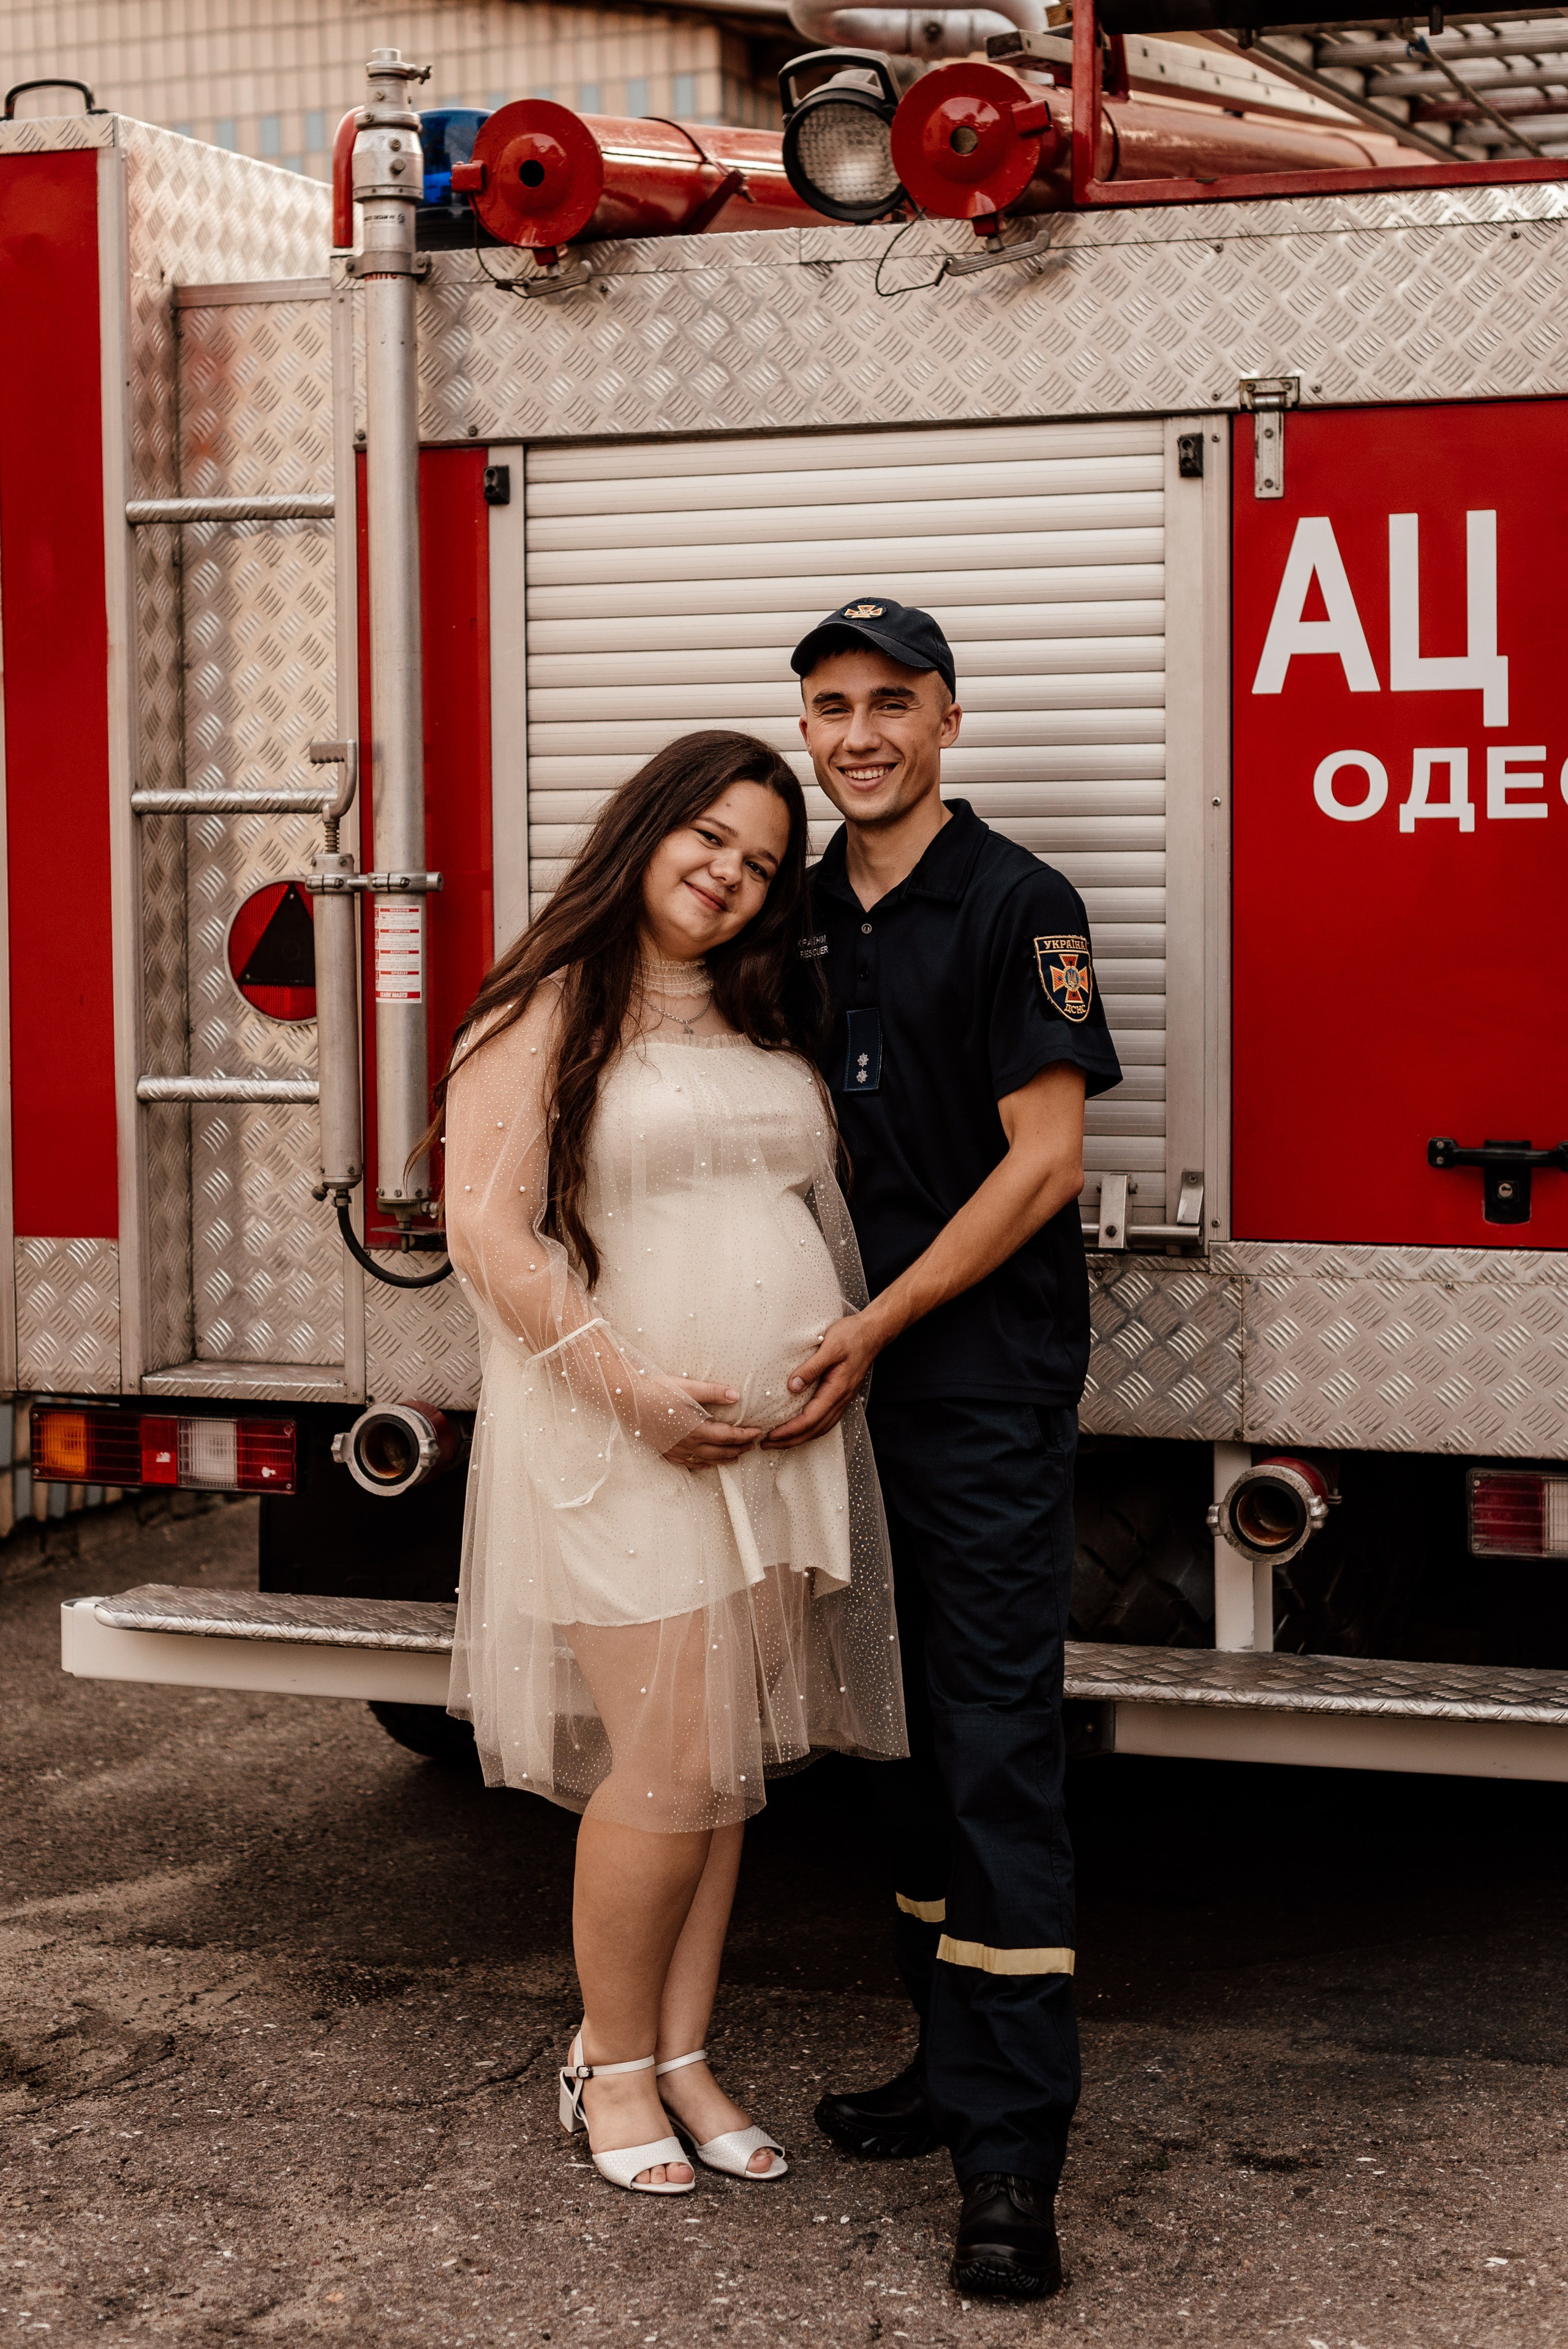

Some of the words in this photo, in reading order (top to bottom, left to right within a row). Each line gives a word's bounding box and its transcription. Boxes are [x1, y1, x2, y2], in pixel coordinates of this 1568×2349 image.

[1251, 510, 1509, 727] АЦ
[1313, 745, 1568, 833] ОДЕ
[797, 934, 826, 948] КРАЇНИ
[1043, 939, 1086, 950] УКРАЇНА
[800, 945, 829, 959] RESCUER
[1064, 1003, 1087, 1014] ДСНС
